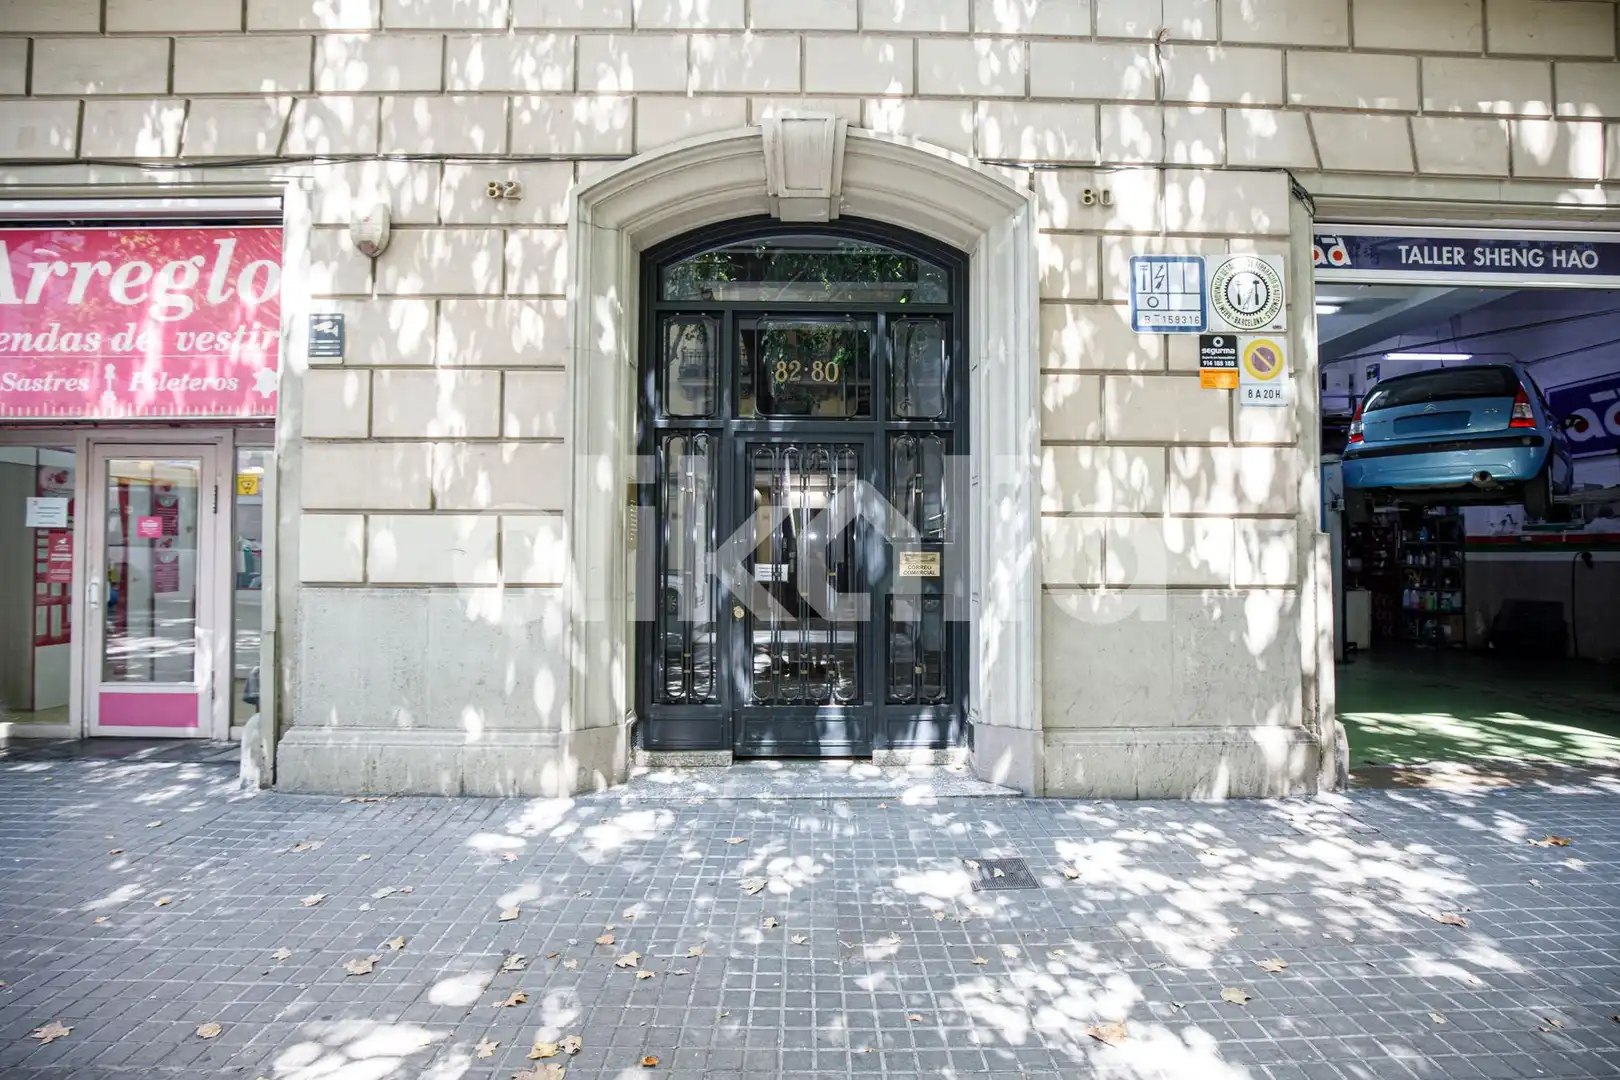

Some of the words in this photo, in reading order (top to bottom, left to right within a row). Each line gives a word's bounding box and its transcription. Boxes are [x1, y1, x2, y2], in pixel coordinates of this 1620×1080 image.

[486, 180, 523, 200] 82
[1398, 245, 1466, 266] TALLER
[1473, 247, 1545, 268] SHENG
[1552, 249, 1599, 269] HAO
[176, 321, 279, 352] vestir
[1201, 347, 1235, 355] segurma
[1, 372, 90, 392] Sastres
[1247, 389, 1253, 399] 8
[1255, 389, 1262, 399] A
[1263, 389, 1274, 399] 20
